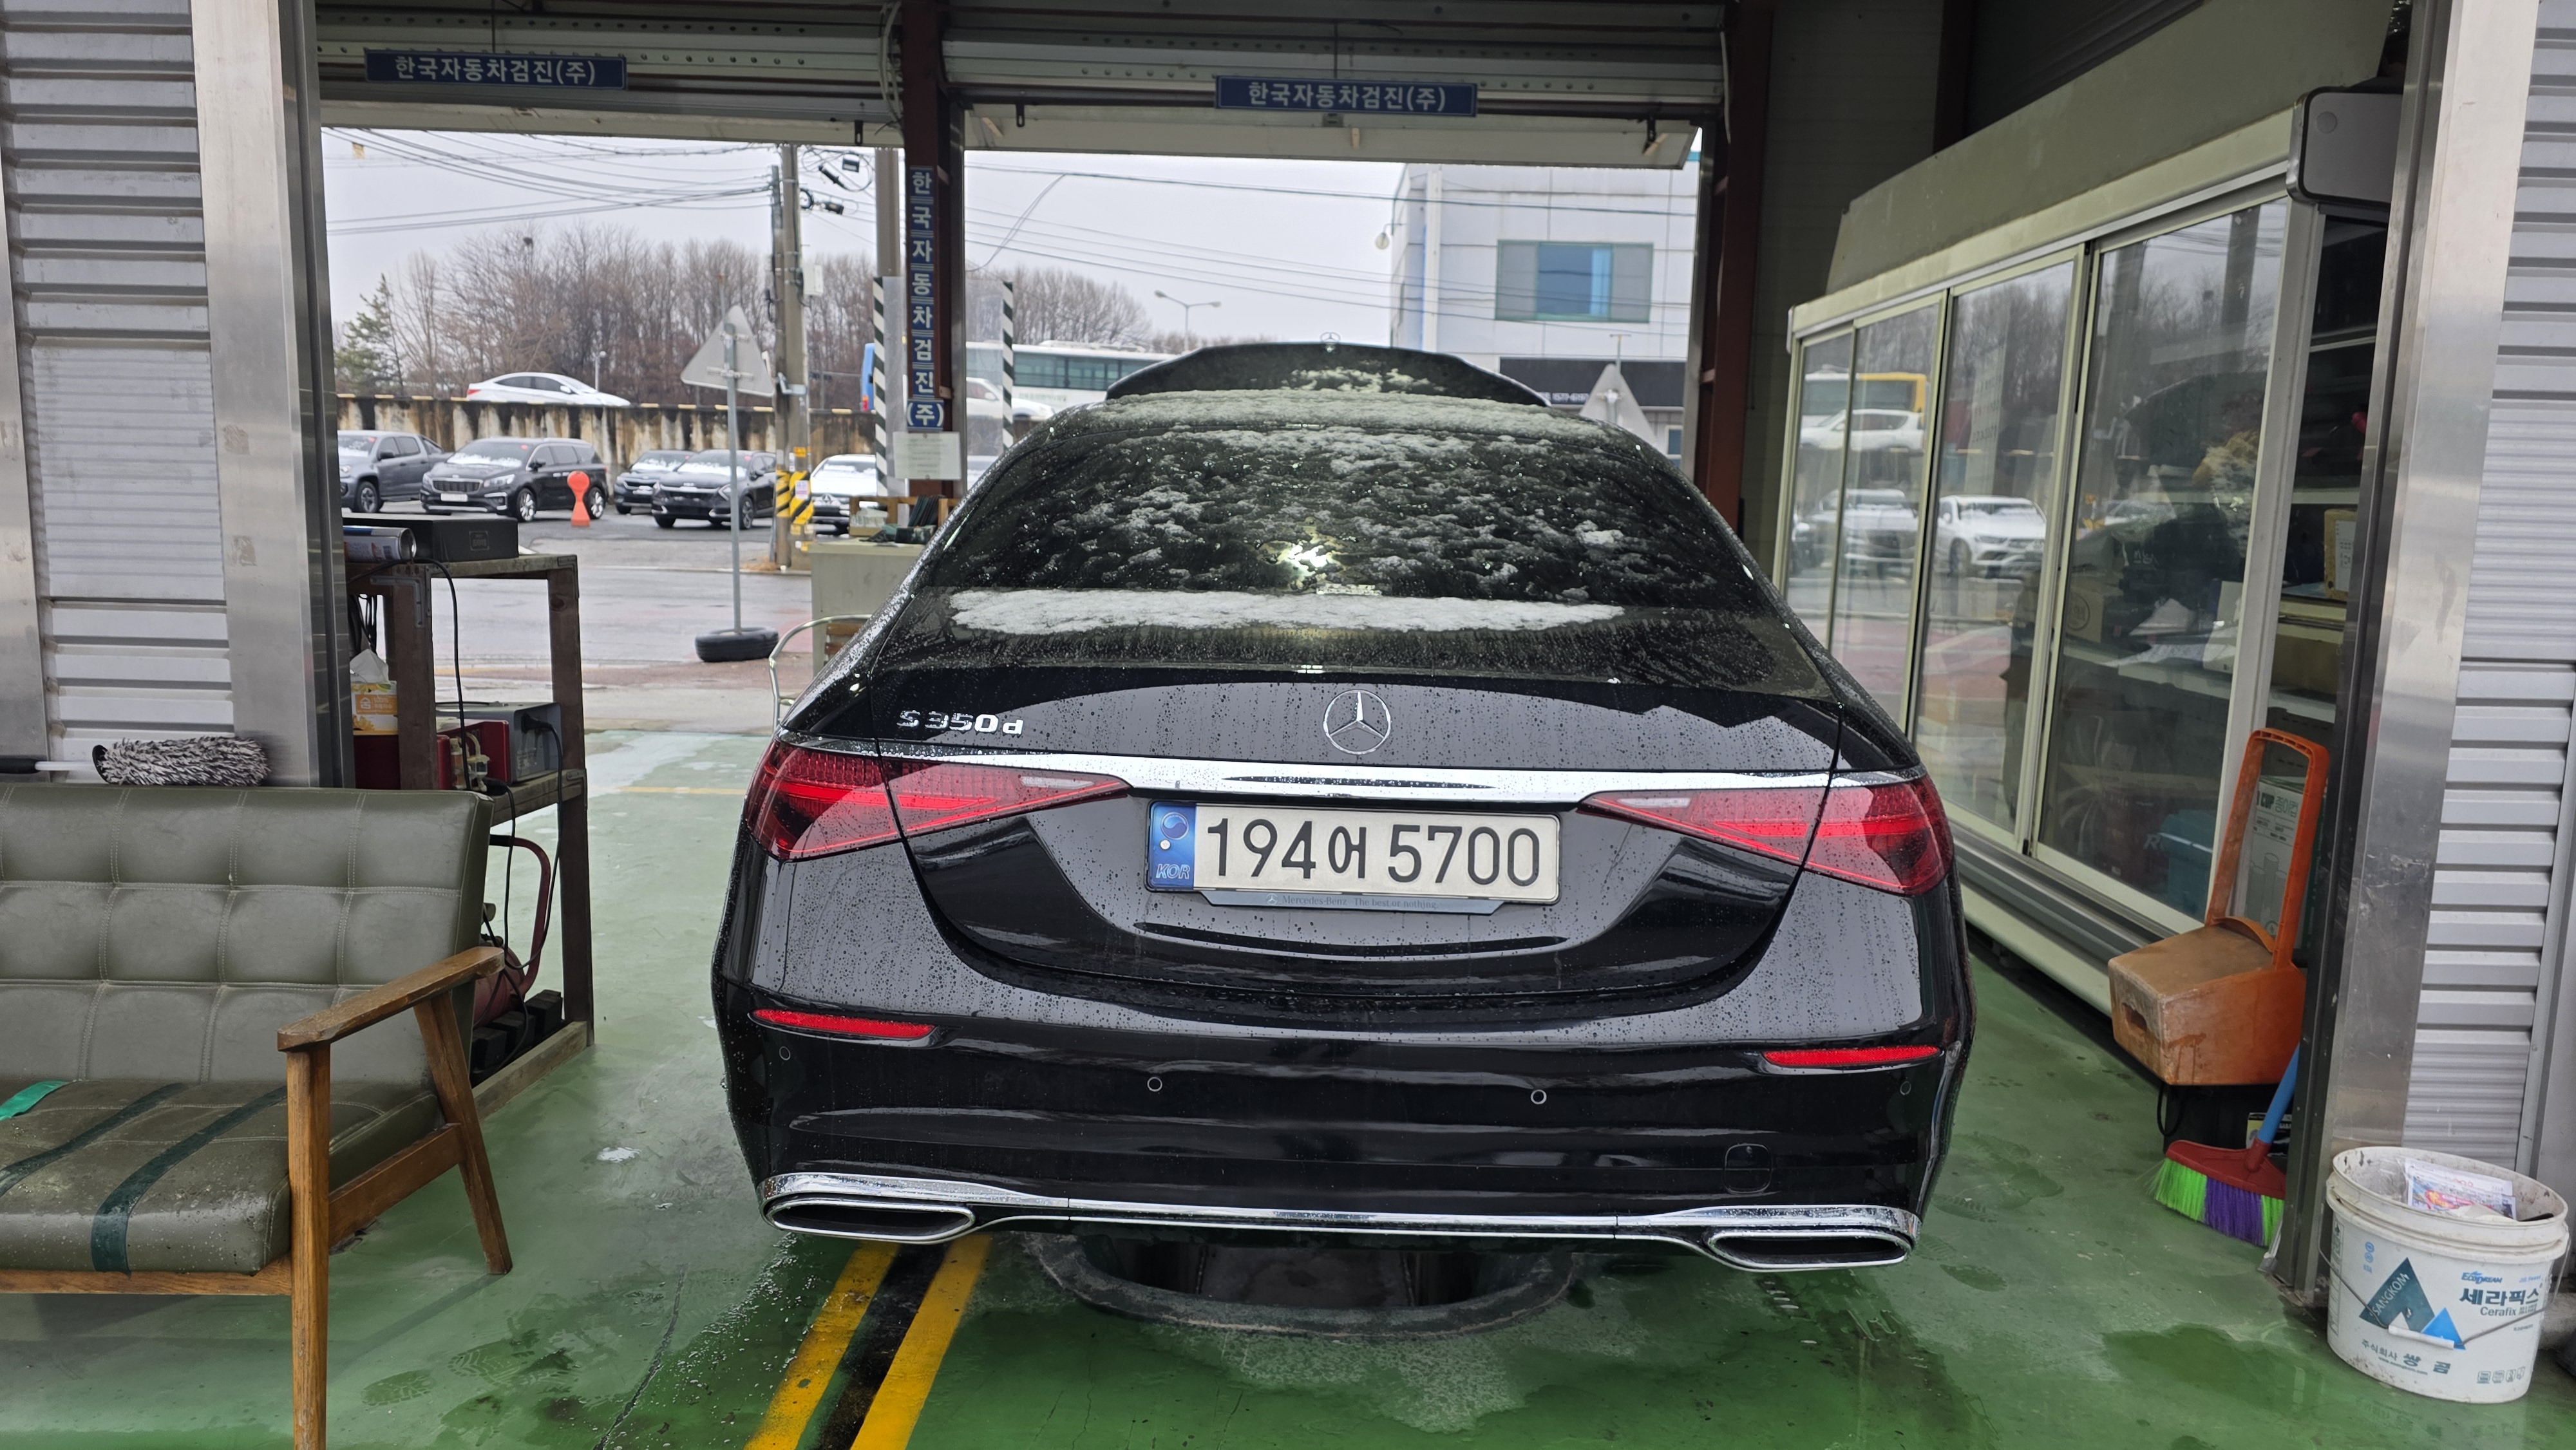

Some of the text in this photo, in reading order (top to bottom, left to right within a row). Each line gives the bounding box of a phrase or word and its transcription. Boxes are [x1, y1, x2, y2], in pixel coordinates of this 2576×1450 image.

[395, 57, 596, 85] 한국자동차검진(주)
[1249, 82, 1446, 111] 한국자동차검진(주)
[1156, 863, 1190, 880] KOR
[1282, 895, 1347, 906] Mercedes-Benz
[1354, 898, 1370, 907] The
[1372, 899, 1390, 907] best
[2459, 1287, 2539, 1306] 세라픽스
[2479, 1306, 2517, 1317] Cerafix
[2361, 1339, 2398, 1361] 주식회사
